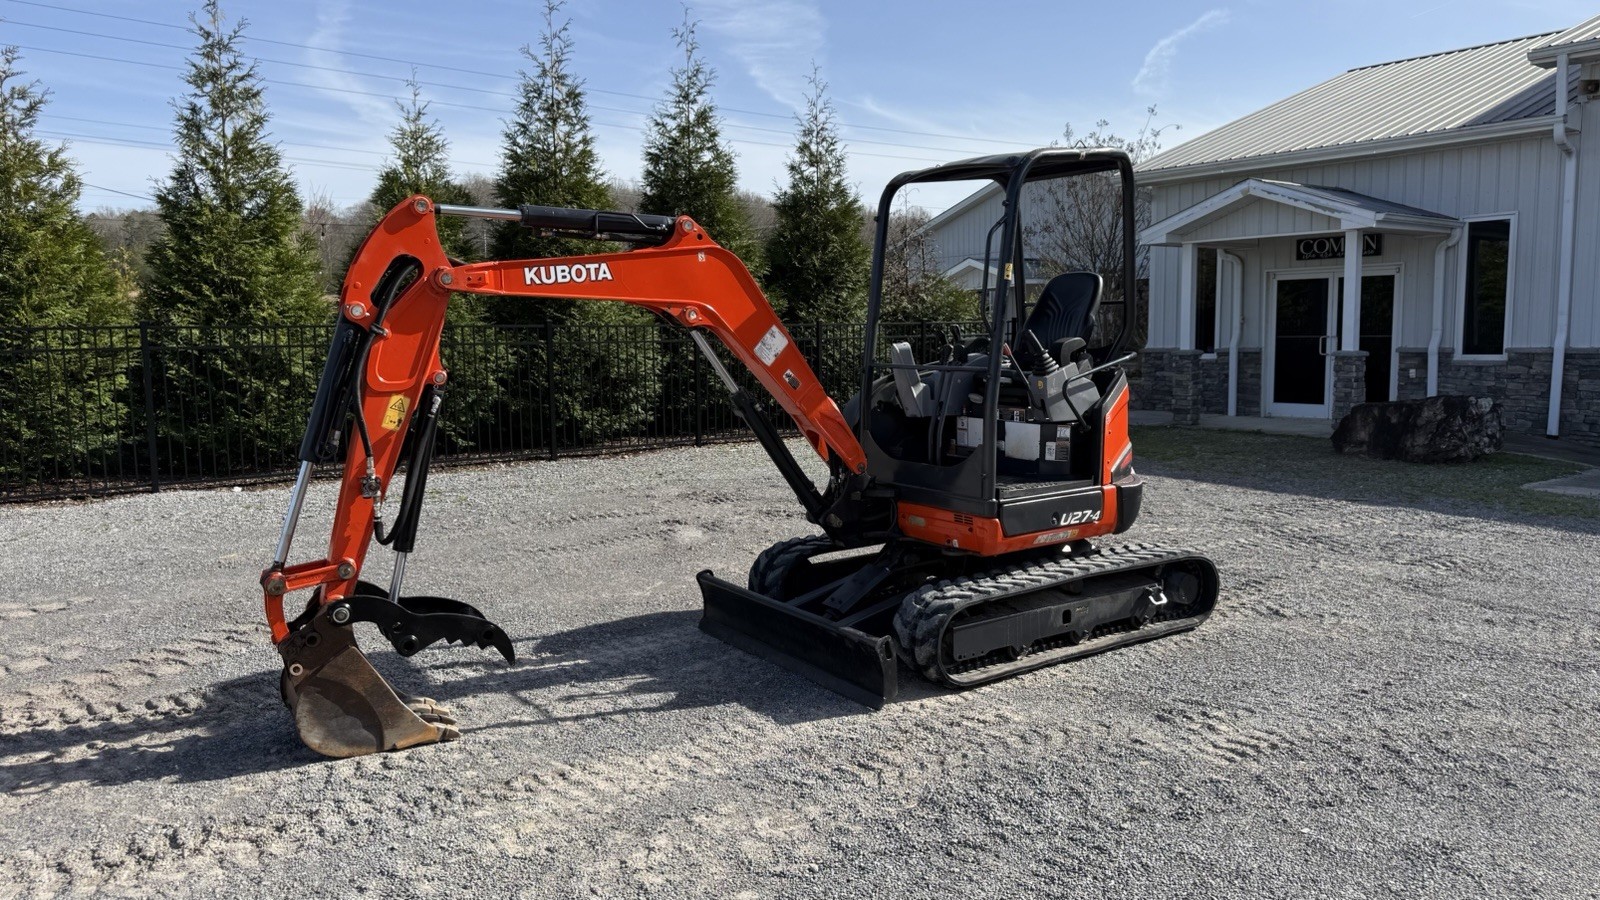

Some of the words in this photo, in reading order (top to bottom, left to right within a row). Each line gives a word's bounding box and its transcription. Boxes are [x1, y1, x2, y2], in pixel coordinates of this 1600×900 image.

[1300, 235, 1377, 255] COMN
[523, 262, 613, 285] KUBOTA
[1060, 510, 1101, 526] U27-4
